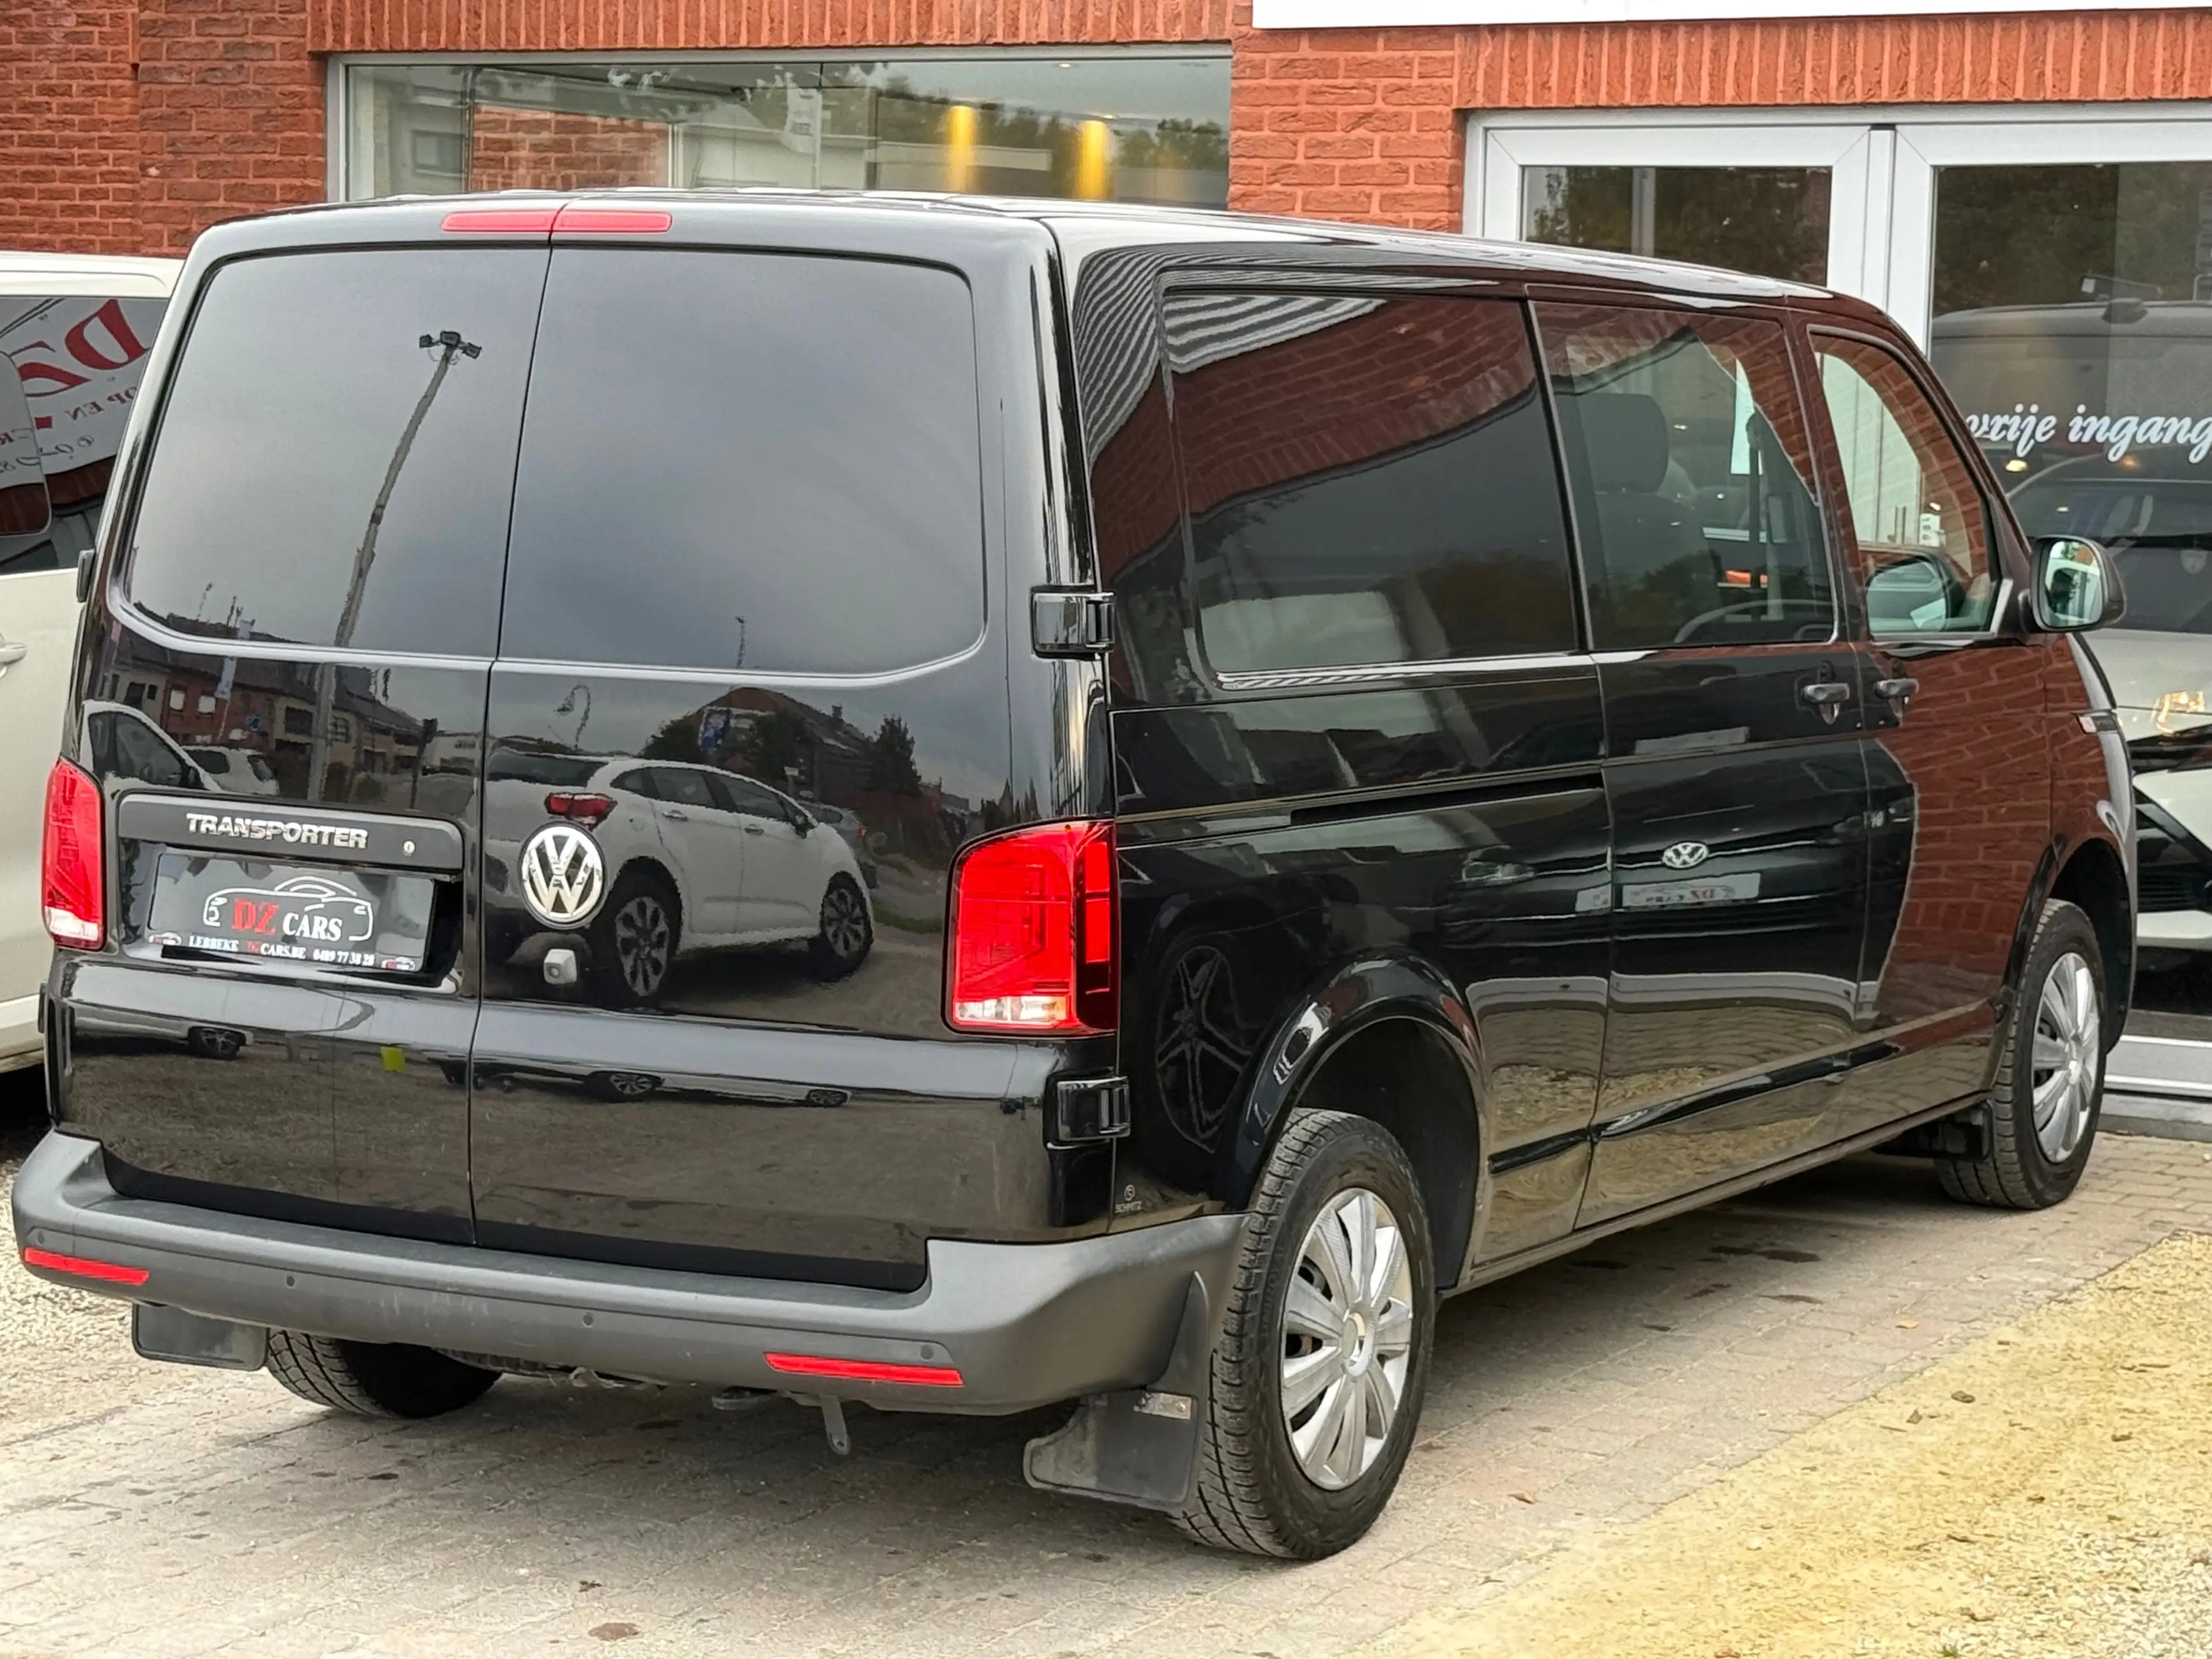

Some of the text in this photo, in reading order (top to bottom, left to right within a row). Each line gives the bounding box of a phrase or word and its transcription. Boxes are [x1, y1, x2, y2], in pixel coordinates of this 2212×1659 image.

[1965, 403, 2058, 457] vrije
[186, 812, 369, 850] TRANSPORTER
[231, 897, 342, 941] DZ CARS
